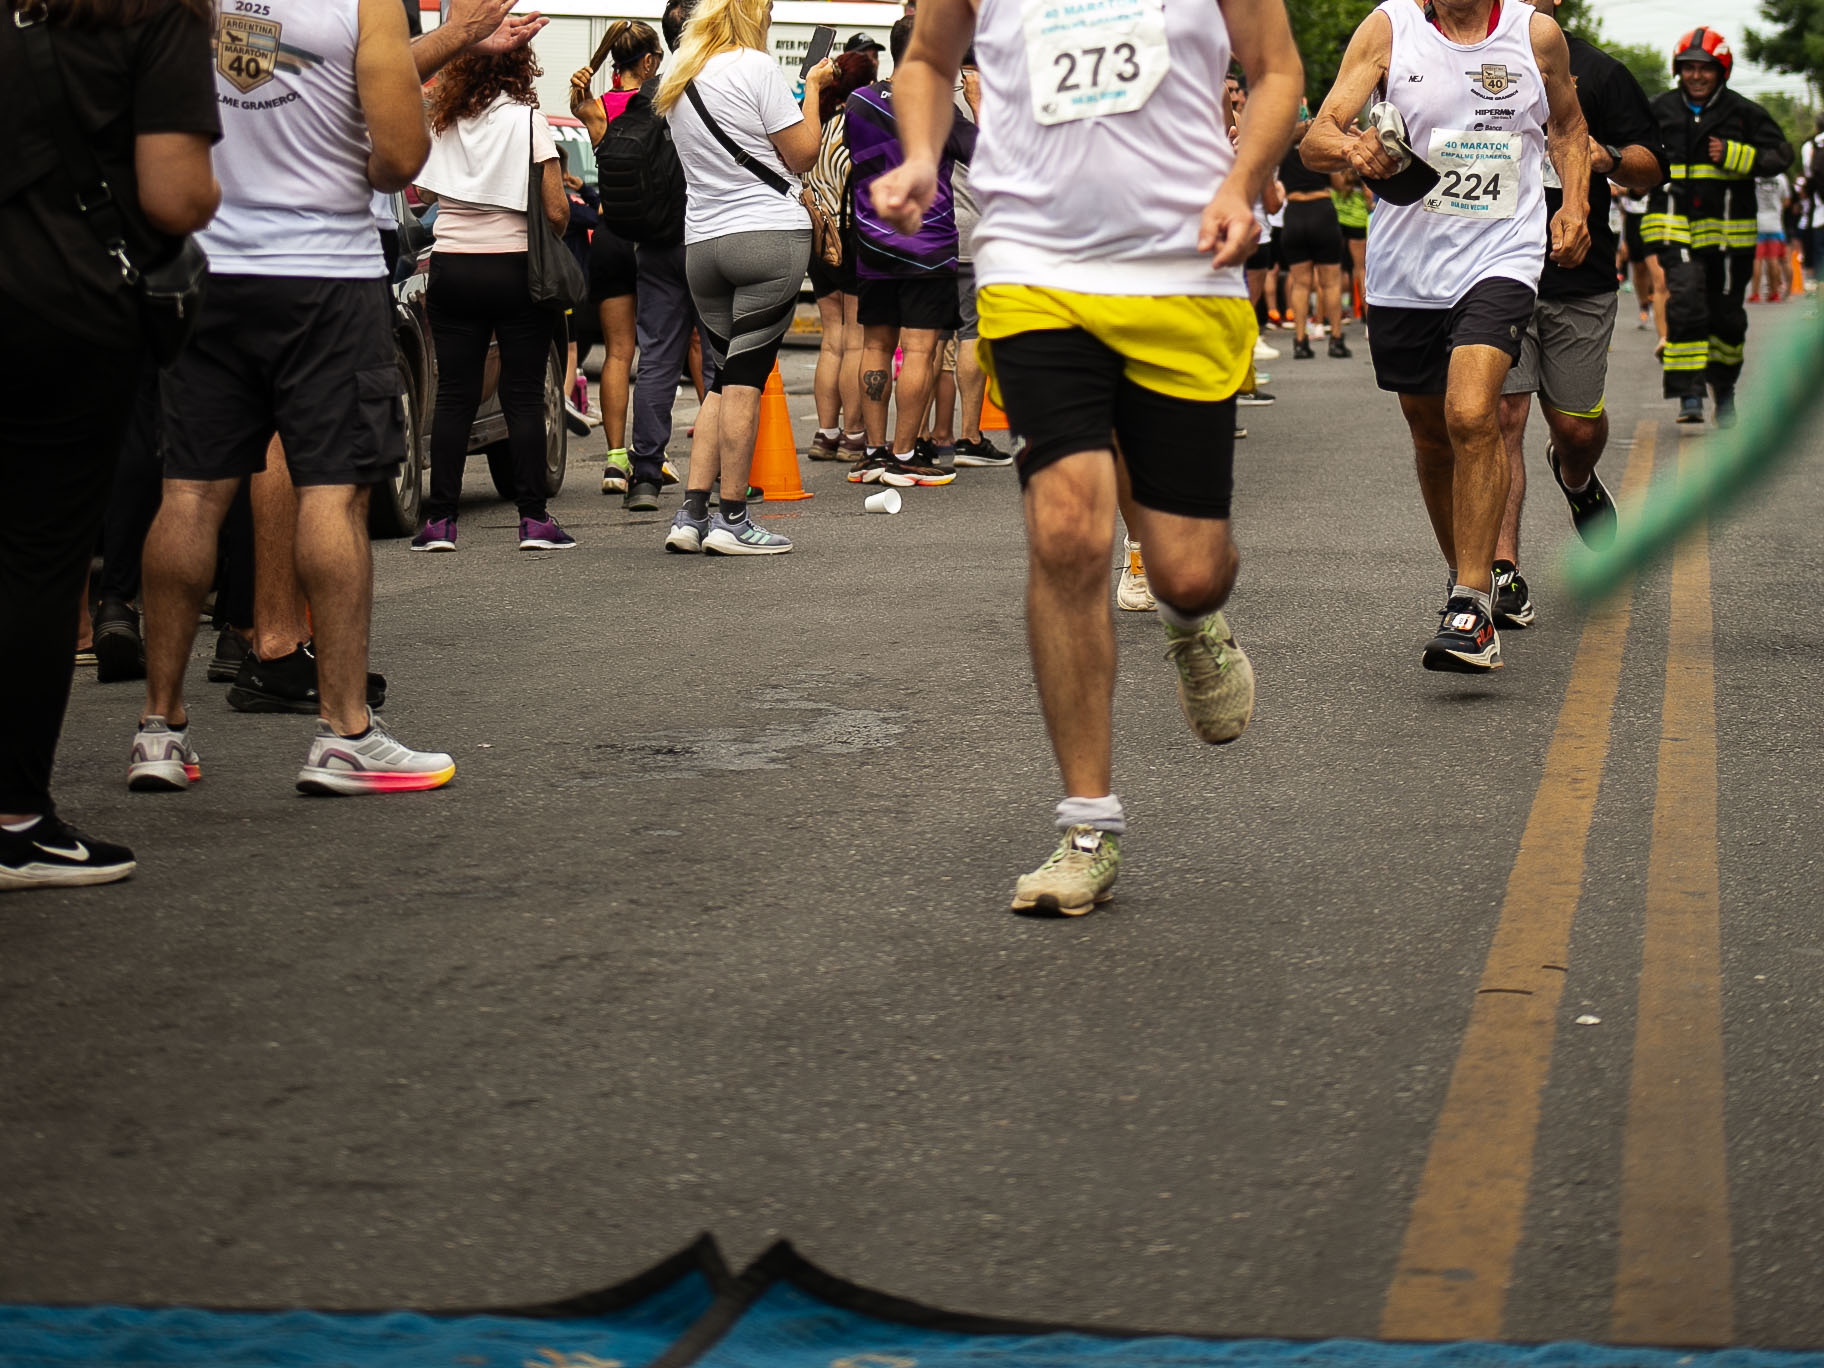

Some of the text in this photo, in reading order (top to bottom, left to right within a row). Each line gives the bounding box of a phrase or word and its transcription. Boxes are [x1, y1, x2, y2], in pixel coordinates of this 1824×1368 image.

[235, 0, 271, 16] 2025
[226, 19, 274, 36] ARGENTINA
[775, 40, 795, 50] AYER
[797, 40, 810, 50] PO
[778, 56, 783, 65] Y
[228, 55, 261, 80] 40
[1053, 42, 1141, 94] 273
[1408, 75, 1424, 83] NEJ
[1488, 79, 1503, 89] 40
[1444, 141, 1509, 151] 40 MARATON
[1440, 151, 1475, 159] EMPALME
[1441, 170, 1501, 201] 224
[1427, 198, 1443, 207] NEJ
